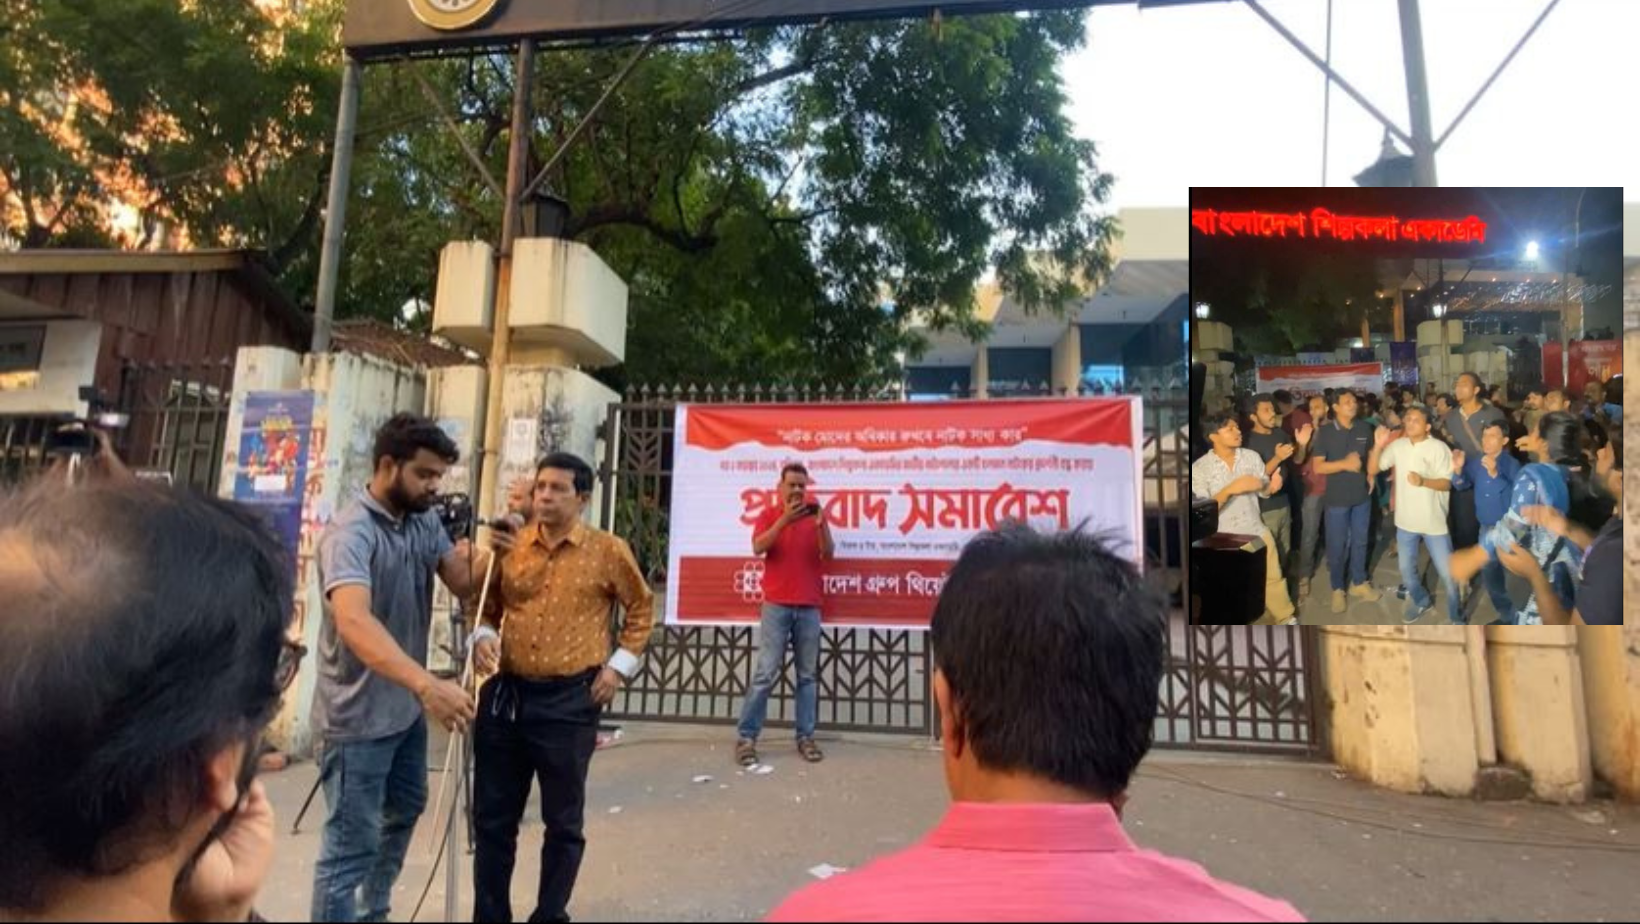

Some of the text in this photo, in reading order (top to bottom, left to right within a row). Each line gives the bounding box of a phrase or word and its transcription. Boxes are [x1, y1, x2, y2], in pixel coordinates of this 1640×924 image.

[1191, 208, 1305, 238] বাংলাদেশ
[1311, 207, 1399, 241] শিল্পকলা
[740, 479, 1070, 534] প্রবাদ সমাবেশ
[823, 571, 949, 596] াদেশ গ্রুপ থিয়ে
